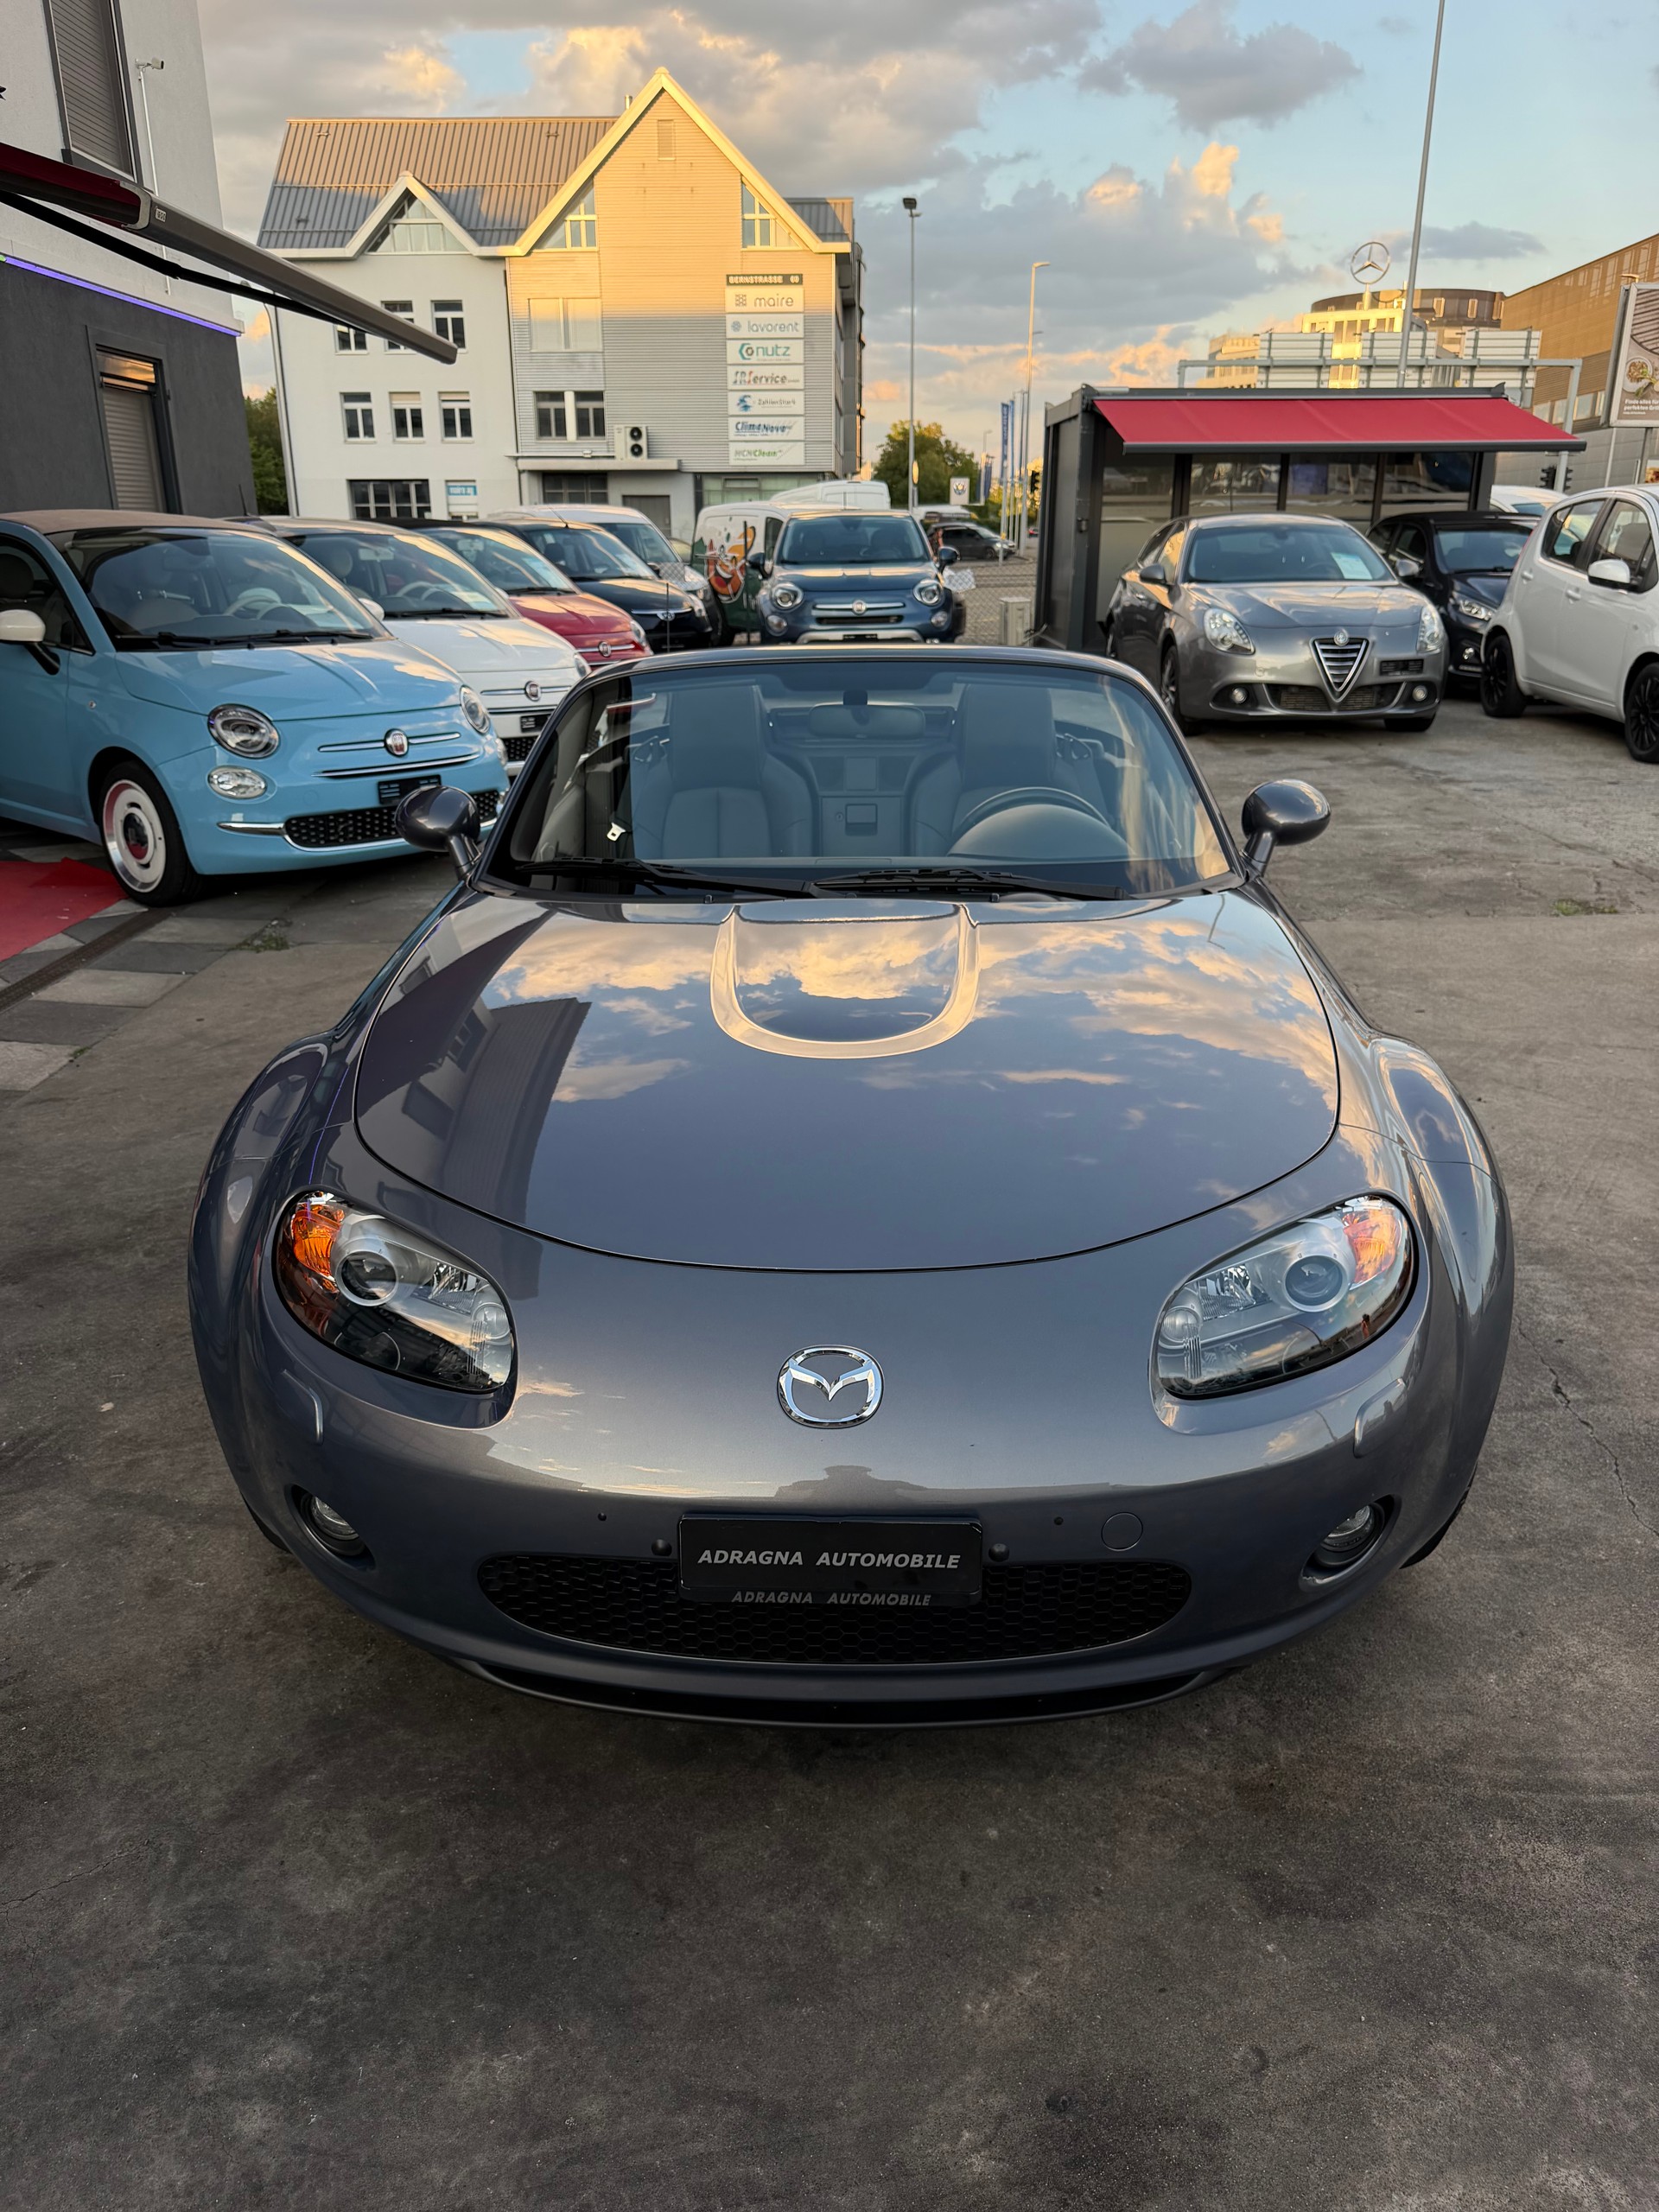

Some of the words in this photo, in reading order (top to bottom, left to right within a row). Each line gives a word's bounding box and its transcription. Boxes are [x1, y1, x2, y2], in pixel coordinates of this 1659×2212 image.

[754, 293, 793, 307] maire
[747, 321, 799, 333] lavorent
[697, 1549, 804, 1566] ADRAGNA
[815, 1552, 961, 1569] AUTOMOBILE
[732, 1591, 813, 1605] ADRAGNA
[826, 1592, 931, 1606] AUTOMOBILE
